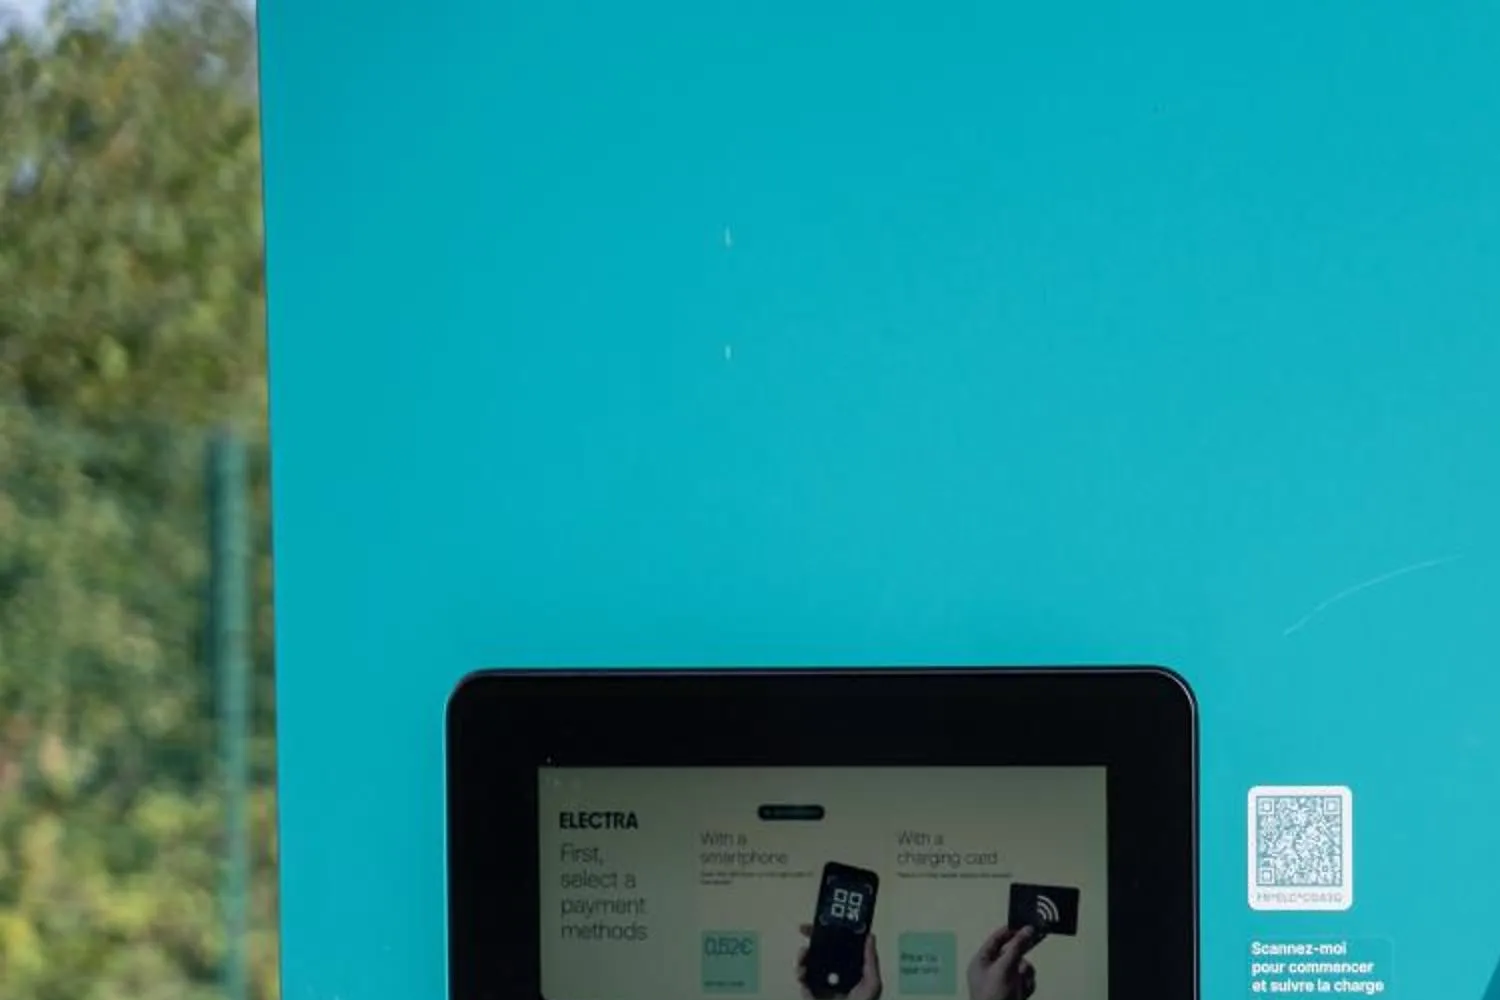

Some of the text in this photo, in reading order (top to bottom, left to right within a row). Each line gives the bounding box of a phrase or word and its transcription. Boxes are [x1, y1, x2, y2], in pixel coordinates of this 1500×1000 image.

[559, 812, 638, 829] ELECTRA
[701, 832, 747, 845] With a
[898, 831, 943, 845] With a
[561, 843, 604, 865] First,
[701, 852, 788, 866] smartphone
[898, 852, 997, 866] charging card
[561, 872, 636, 888] select a
[562, 898, 646, 918] payment
[561, 922, 648, 940] methods
[1251, 942, 1346, 955] Scannez-moi
[1252, 962, 1374, 976] pour commencer
[1252, 979, 1384, 995] et suivre la charge
